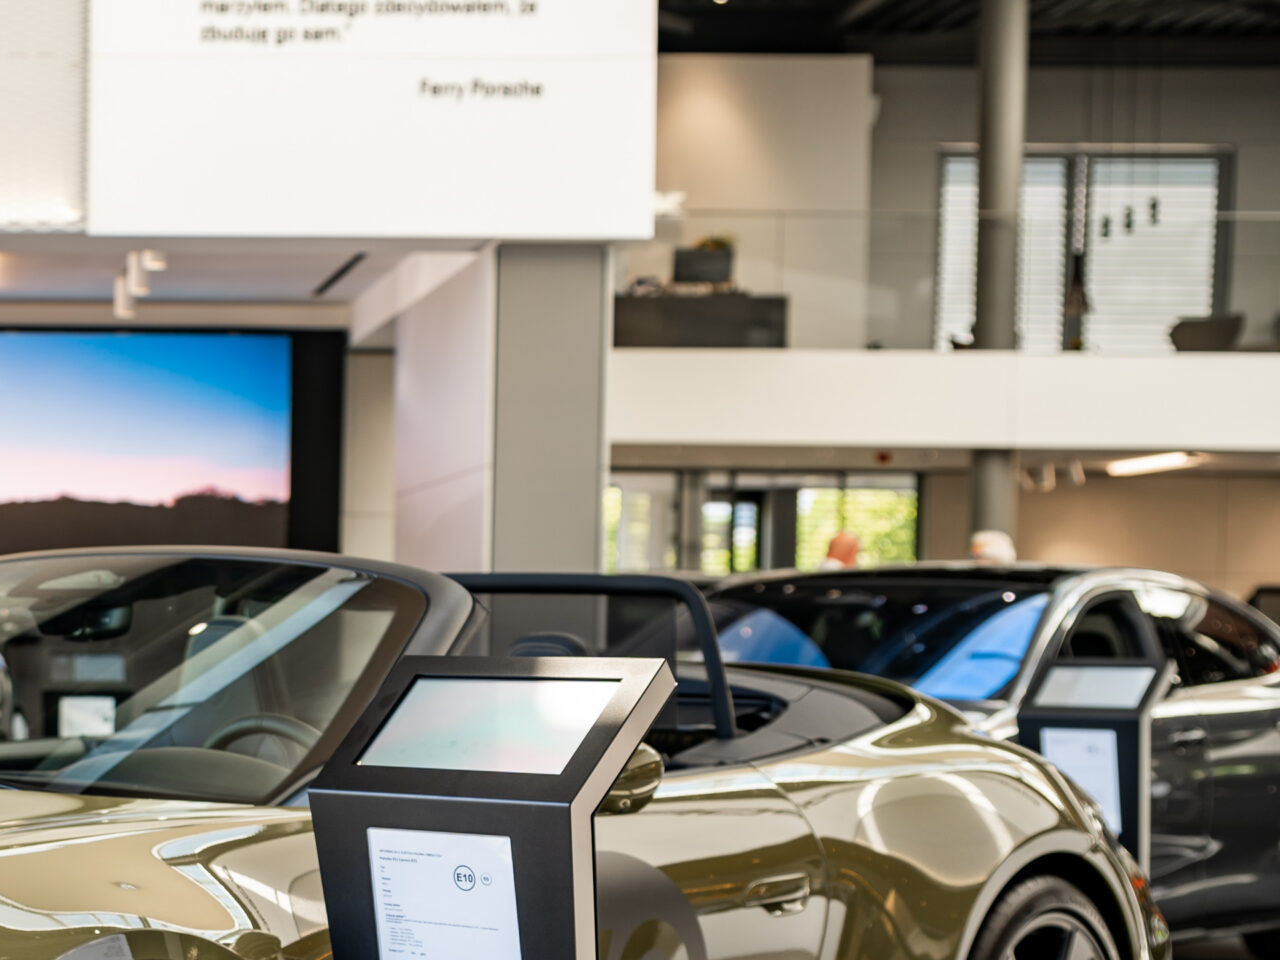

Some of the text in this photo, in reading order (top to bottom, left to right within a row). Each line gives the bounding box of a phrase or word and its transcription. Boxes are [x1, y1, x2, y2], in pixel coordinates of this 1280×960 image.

[420, 77, 543, 101] Ferry Porsche
[456, 872, 474, 884] E10
